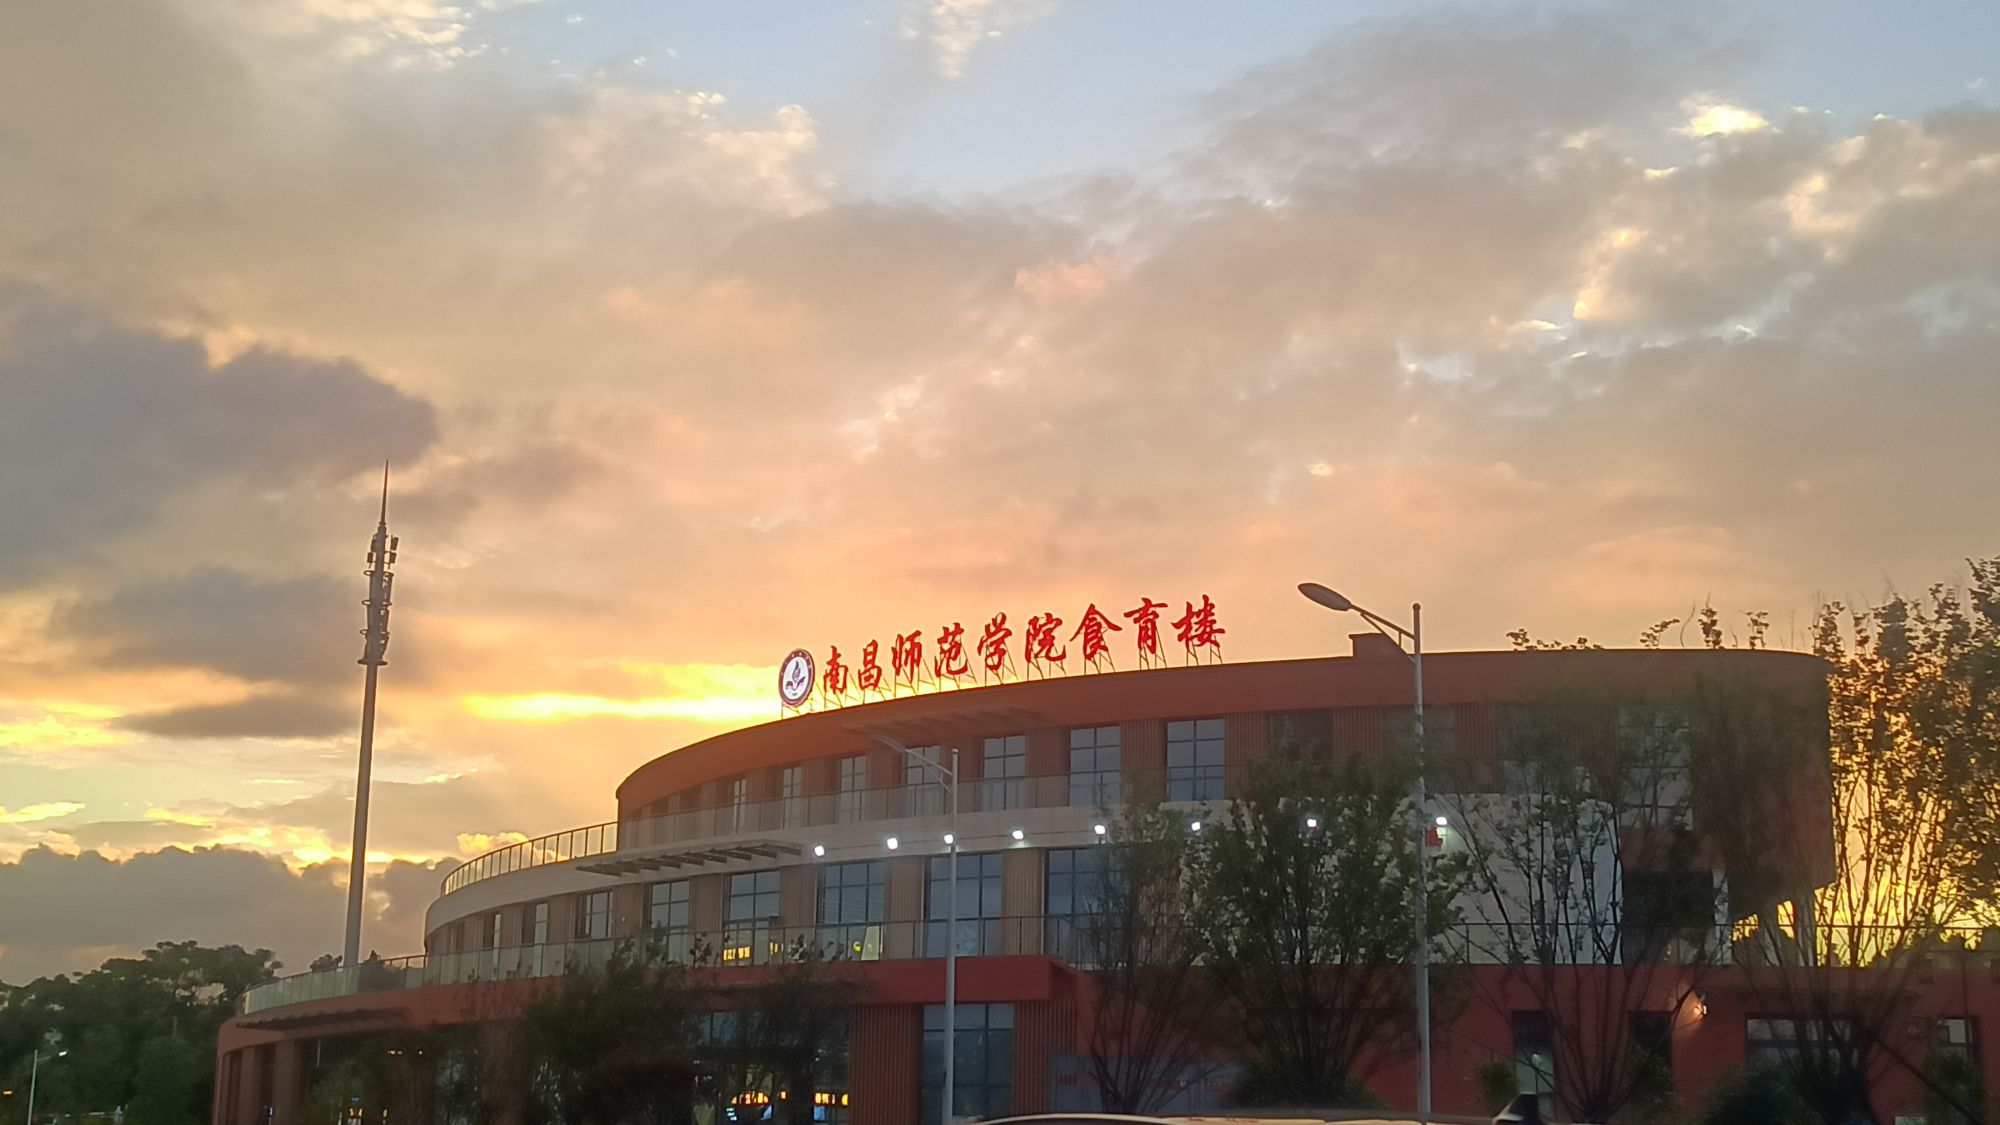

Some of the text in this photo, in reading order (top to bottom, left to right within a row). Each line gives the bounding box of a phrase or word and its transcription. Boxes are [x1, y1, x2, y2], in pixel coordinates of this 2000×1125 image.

[823, 594, 1226, 694] 南昌师范学院食育楼
